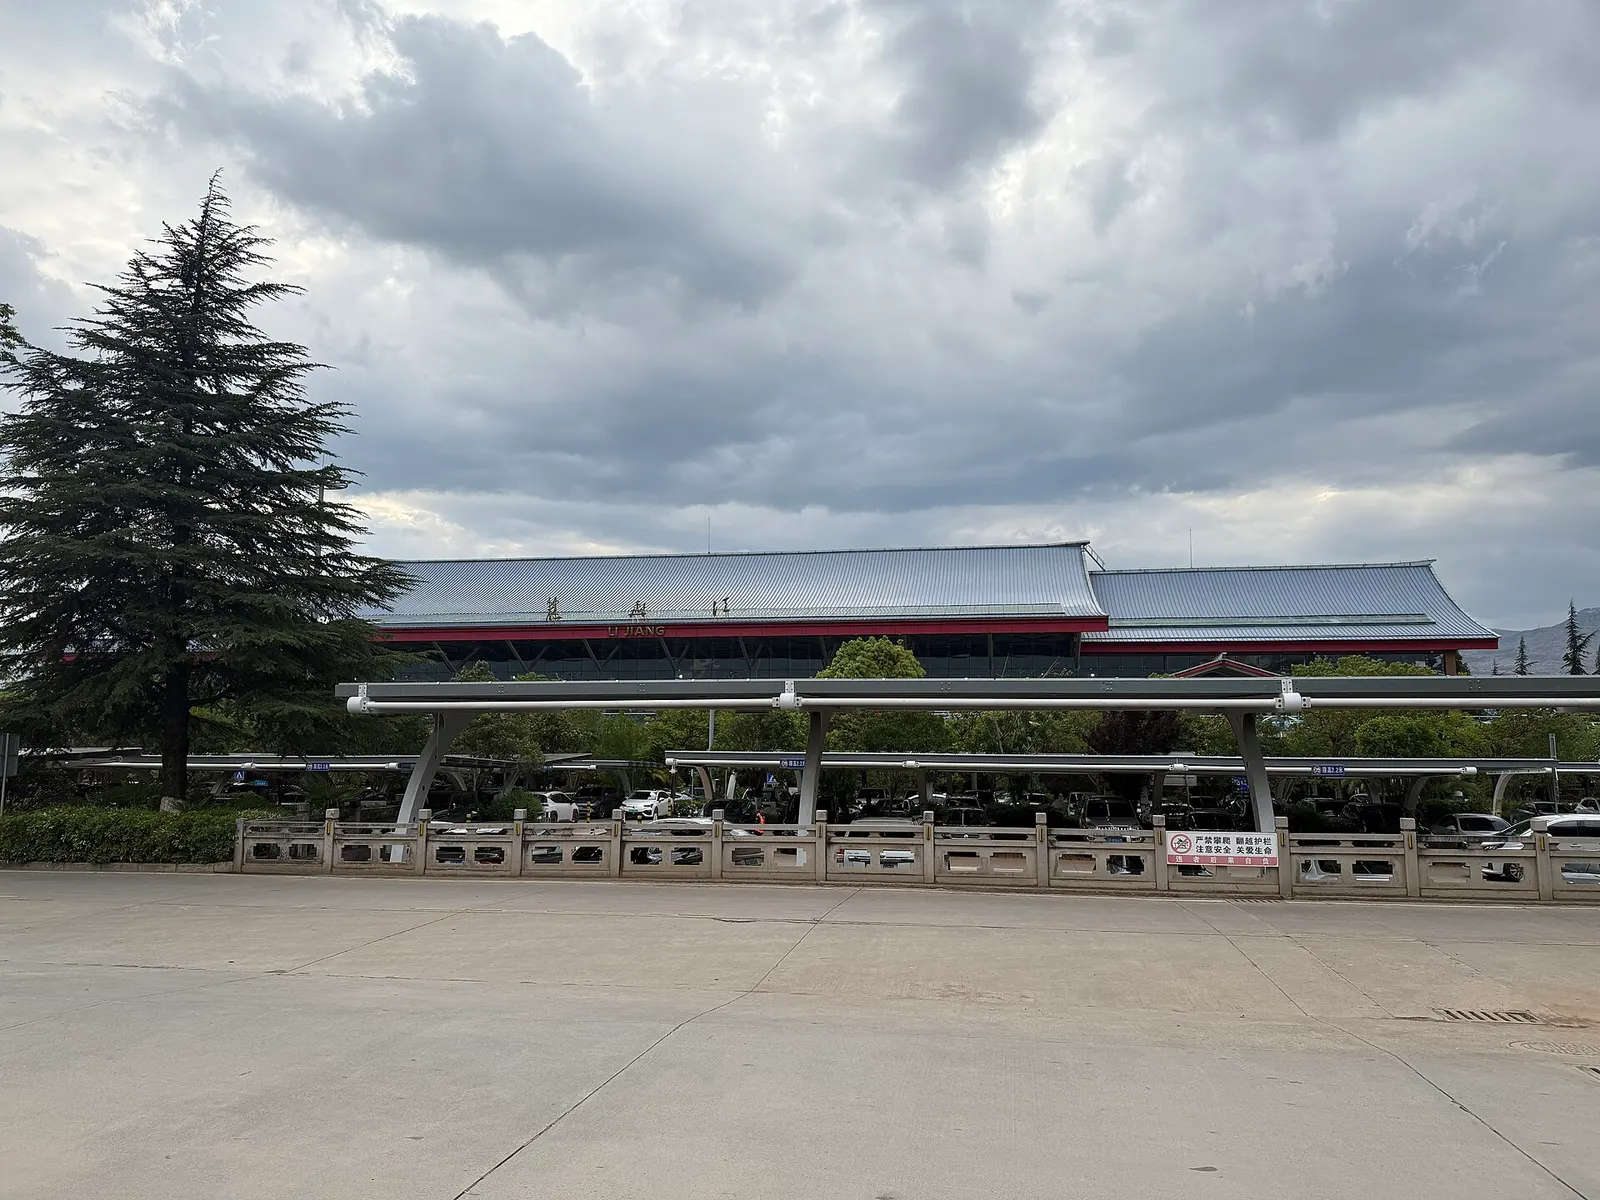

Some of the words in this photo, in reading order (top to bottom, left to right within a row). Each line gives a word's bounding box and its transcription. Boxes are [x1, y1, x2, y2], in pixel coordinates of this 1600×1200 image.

[608, 626, 618, 636] LI
[624, 626, 665, 636] JIANG
[1195, 835, 1231, 844] 严禁攀爬
[1235, 836, 1272, 846] 翻越护栏
[1195, 844, 1232, 854] 注意安全
[1236, 846, 1273, 855] 关爱生命
[1175, 855, 1270, 865] 违者后果自负
